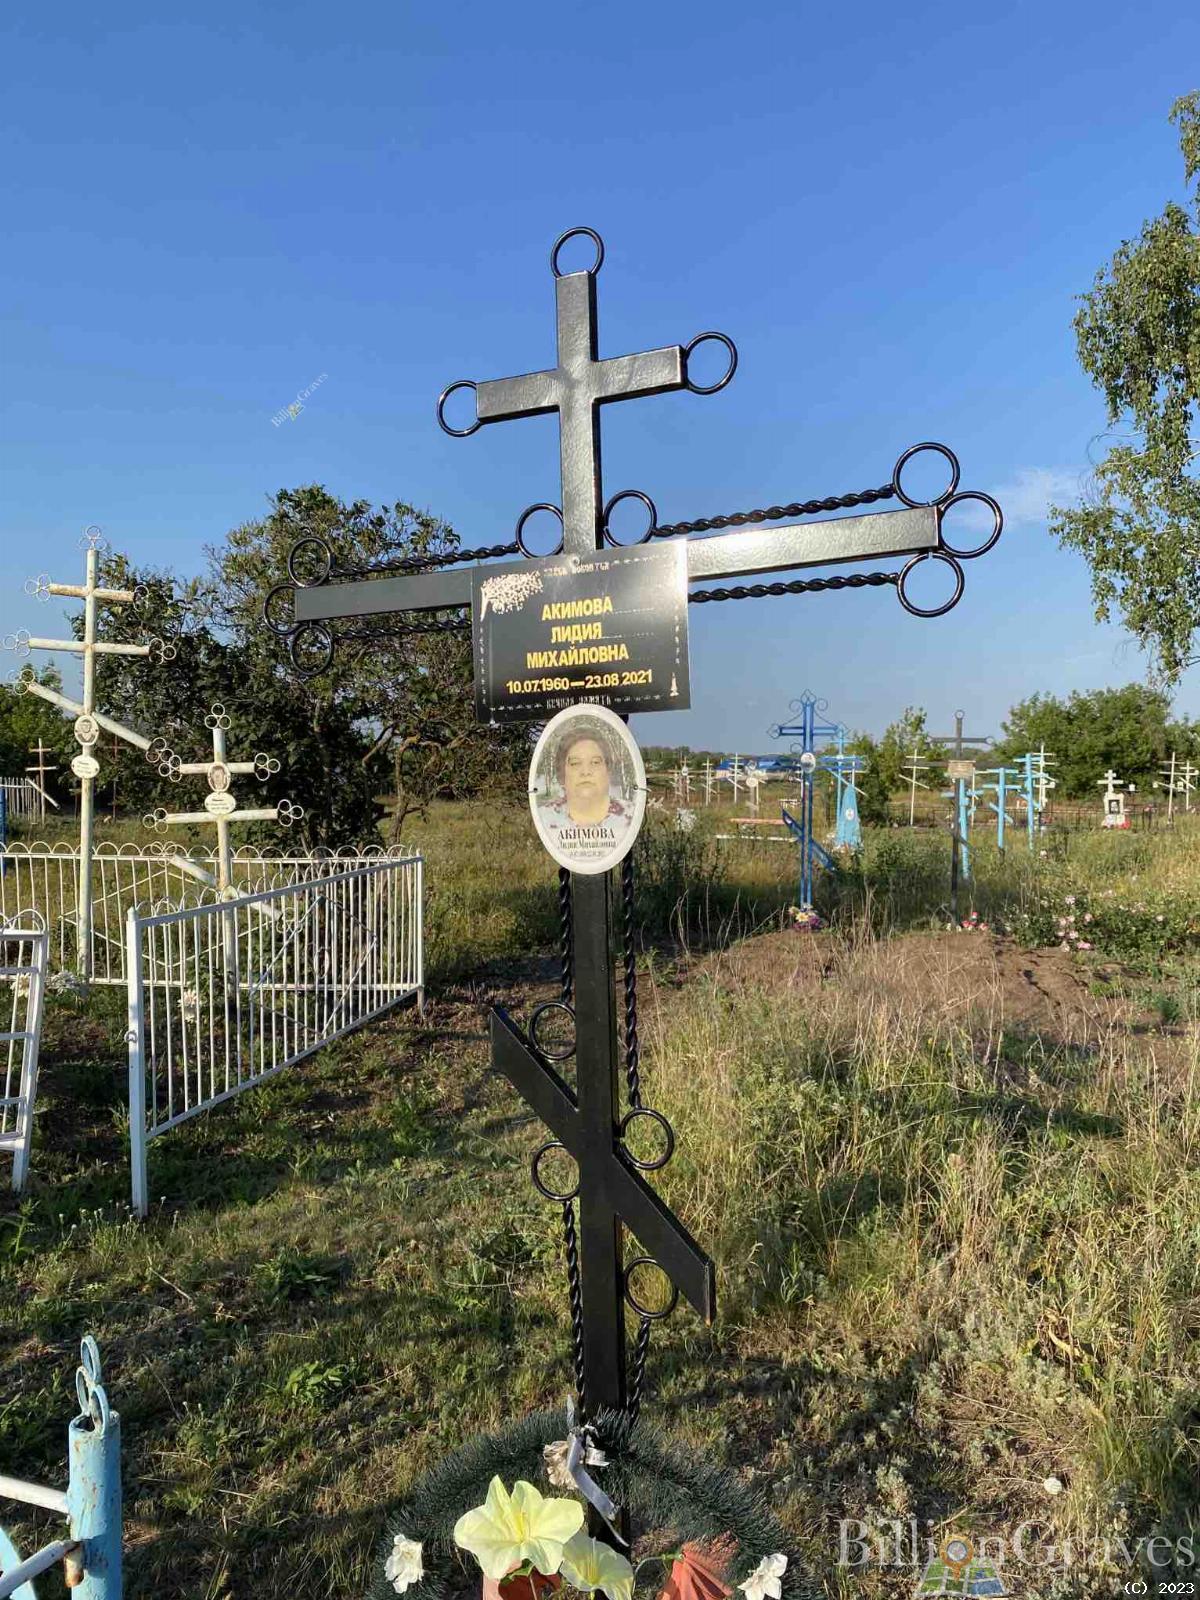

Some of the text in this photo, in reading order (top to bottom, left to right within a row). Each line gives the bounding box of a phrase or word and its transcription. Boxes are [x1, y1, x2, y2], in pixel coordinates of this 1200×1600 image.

[541, 596, 613, 621] АКИМОВА
[551, 622, 603, 645] ЛИДИЯ
[526, 643, 630, 669] МИХАЙЛОВНА
[558, 827, 615, 840] АКИМОВА
